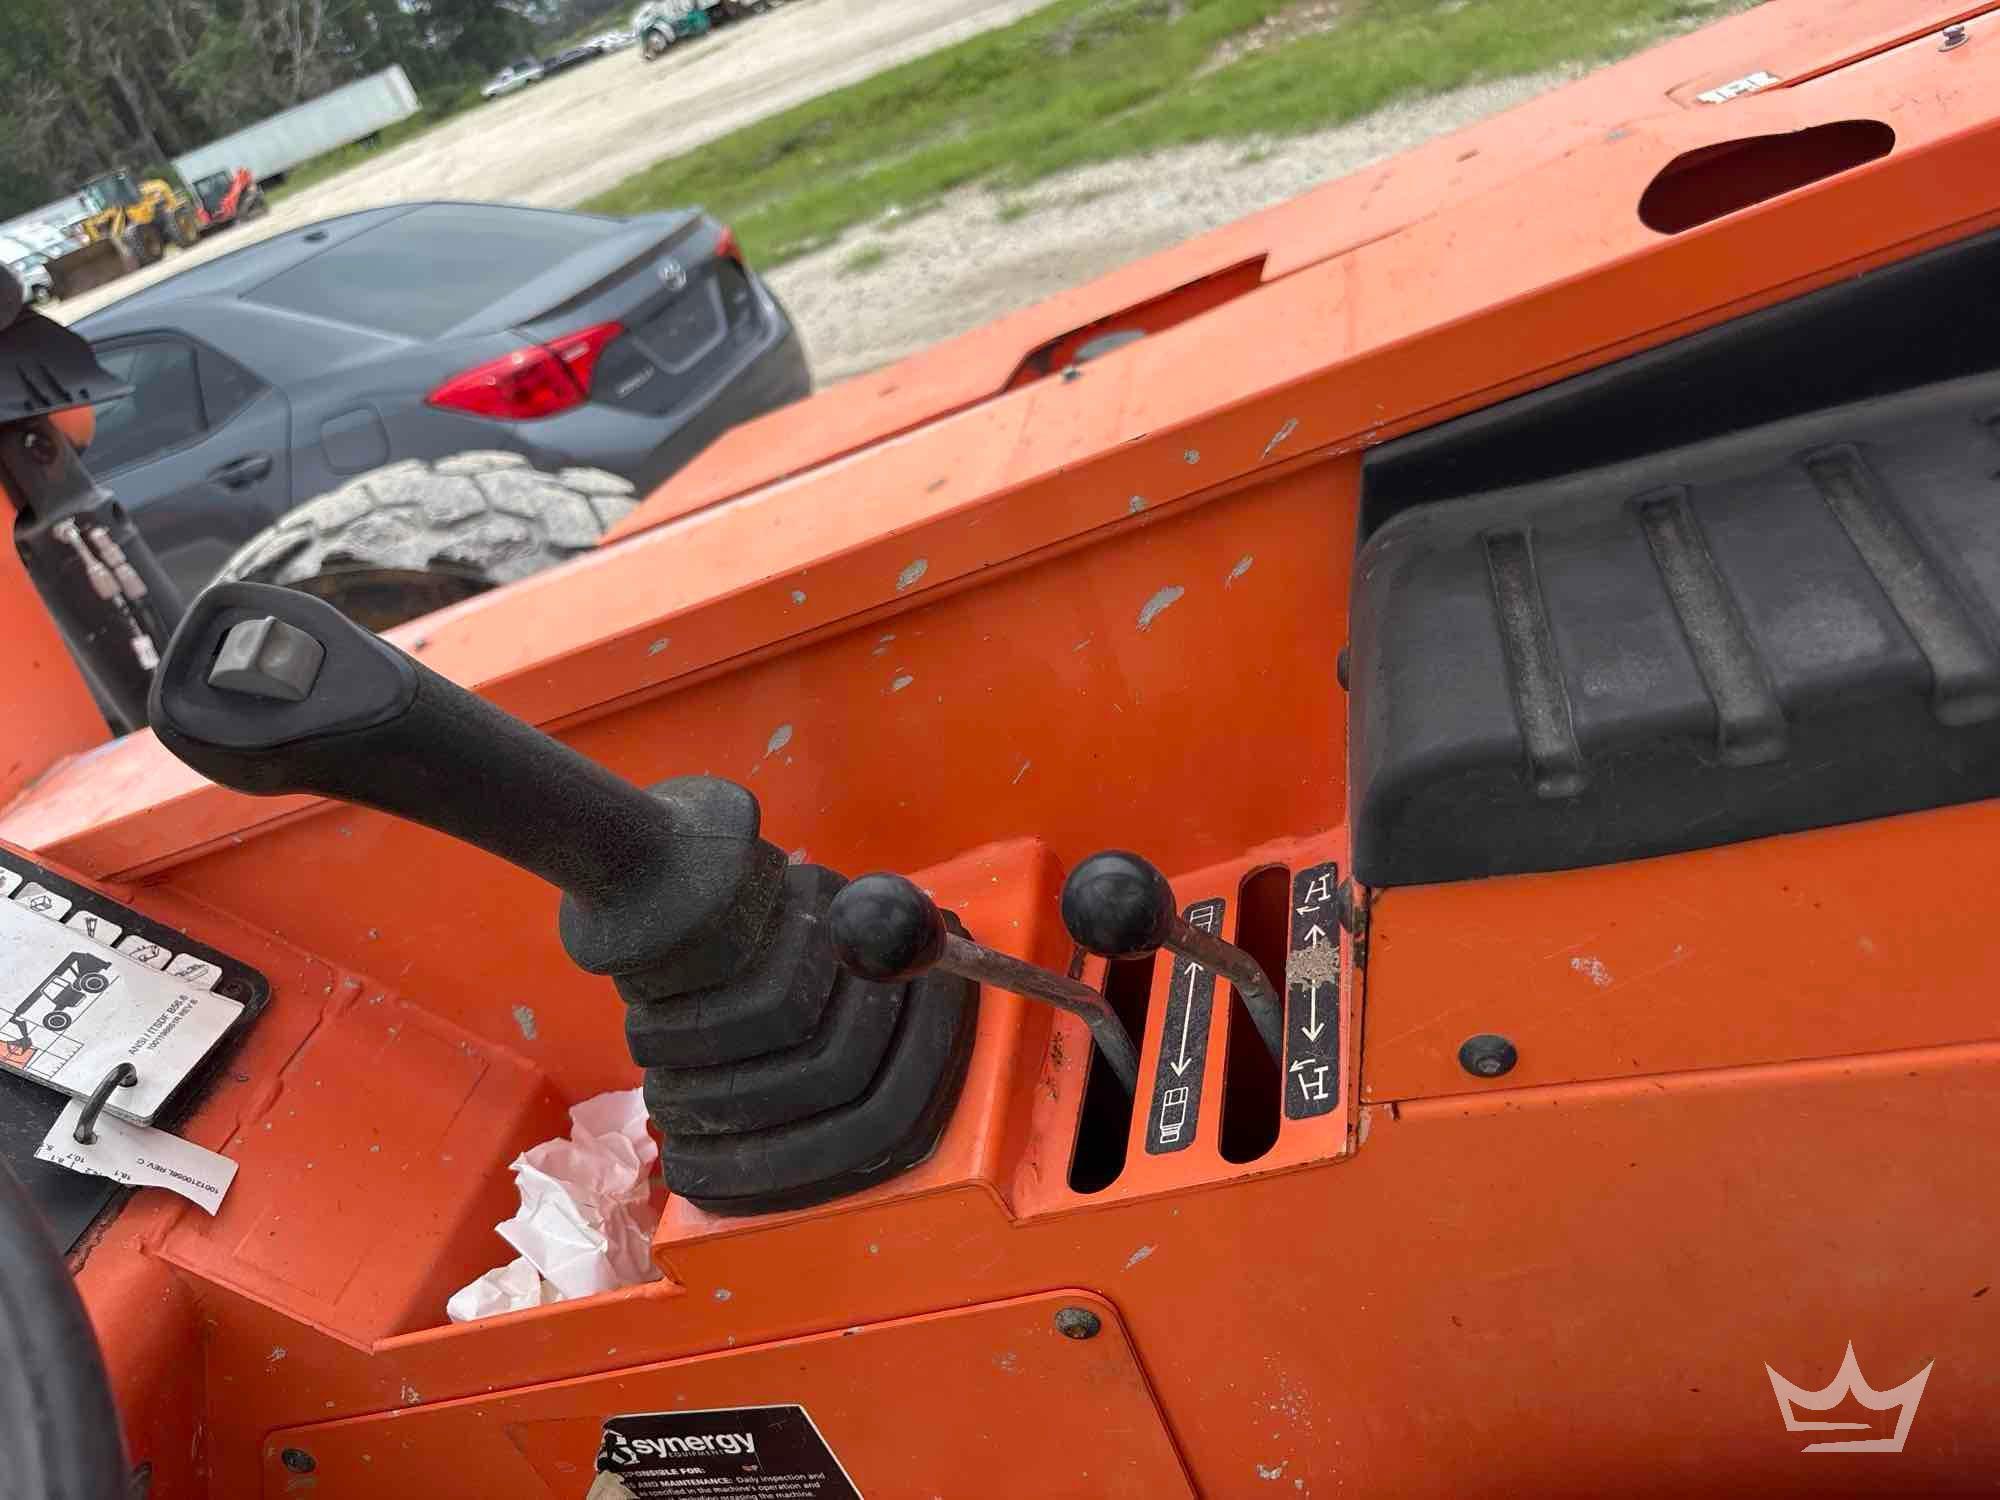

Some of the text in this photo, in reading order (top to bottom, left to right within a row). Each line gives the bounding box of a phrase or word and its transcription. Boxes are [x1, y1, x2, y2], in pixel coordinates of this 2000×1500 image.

[128, 1037, 147, 1056] ANSI
[65, 1152, 87, 1164] 10.7
[135, 1157, 146, 1166] C
[112, 1169, 133, 1181] 18.1
[632, 1433, 755, 1458] synergy
[668, 1449, 727, 1458] EQUIPMENT
[680, 1467, 706, 1475] FOR:
[638, 1480, 659, 1488] AND
[659, 1477, 733, 1487] MAINTENANCE:
[735, 1476, 759, 1484] Daily
[760, 1473, 807, 1483] inspection
[807, 1472, 826, 1480] and
[758, 1482, 802, 1492] operation
[803, 1481, 821, 1489] and
